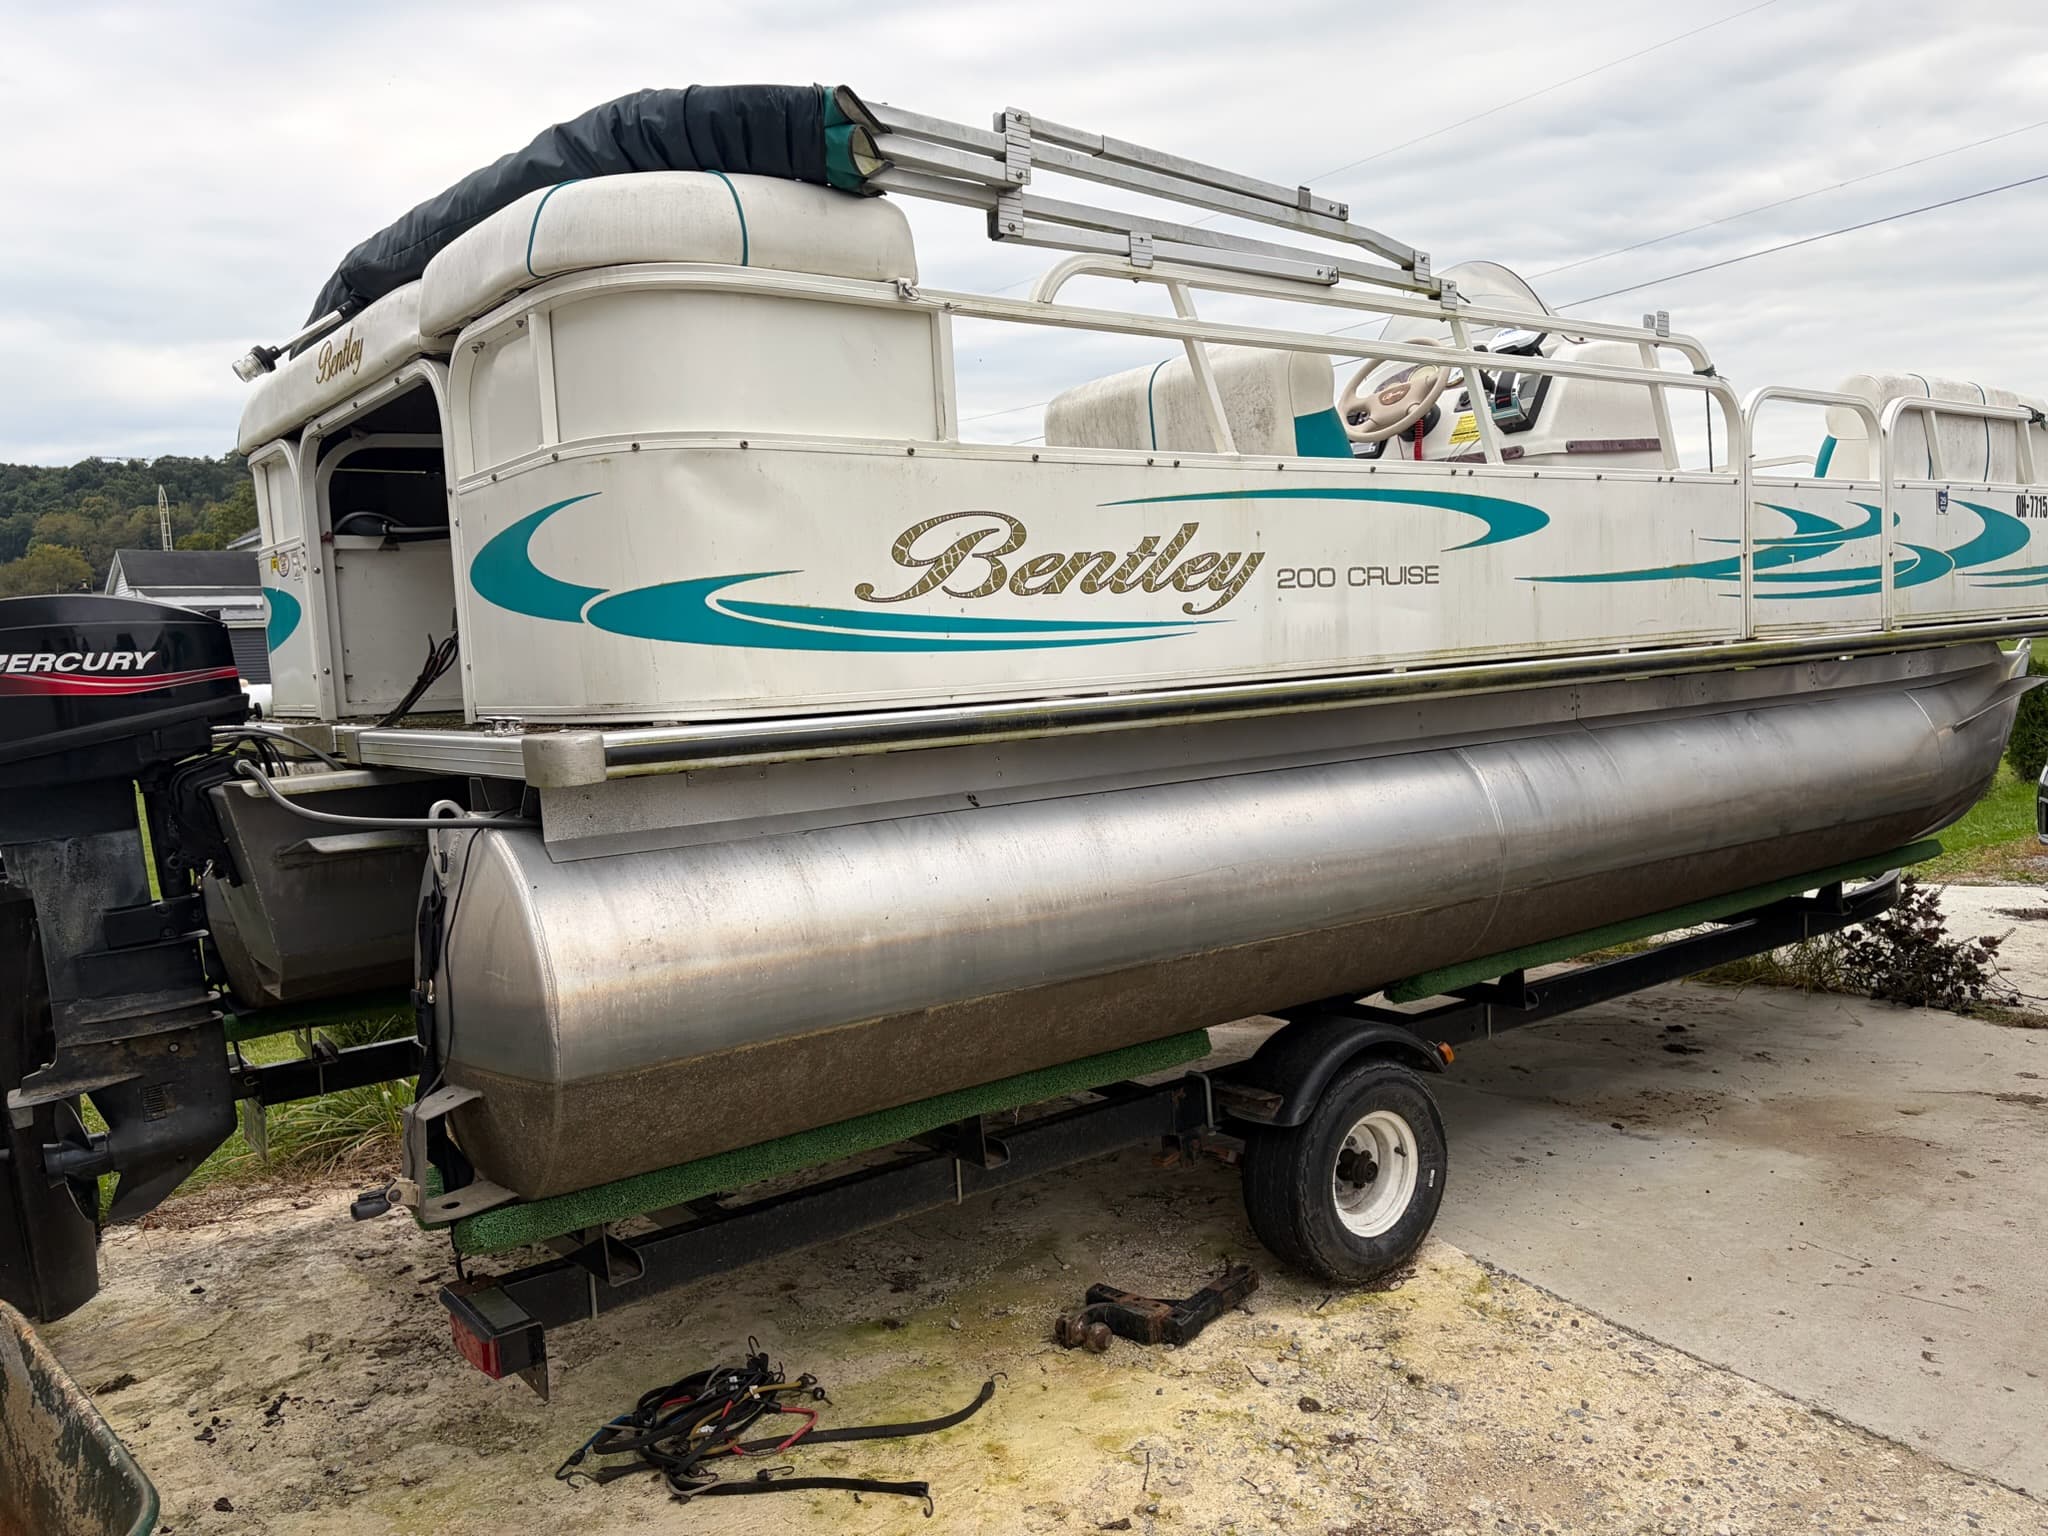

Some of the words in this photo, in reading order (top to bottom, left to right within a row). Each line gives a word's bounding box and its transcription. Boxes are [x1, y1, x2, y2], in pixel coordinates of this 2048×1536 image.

[316, 327, 363, 384] Bentley
[855, 511, 1265, 614] Bentley
[1277, 567, 1336, 589] 200
[1347, 565, 1440, 587] CRUISE
